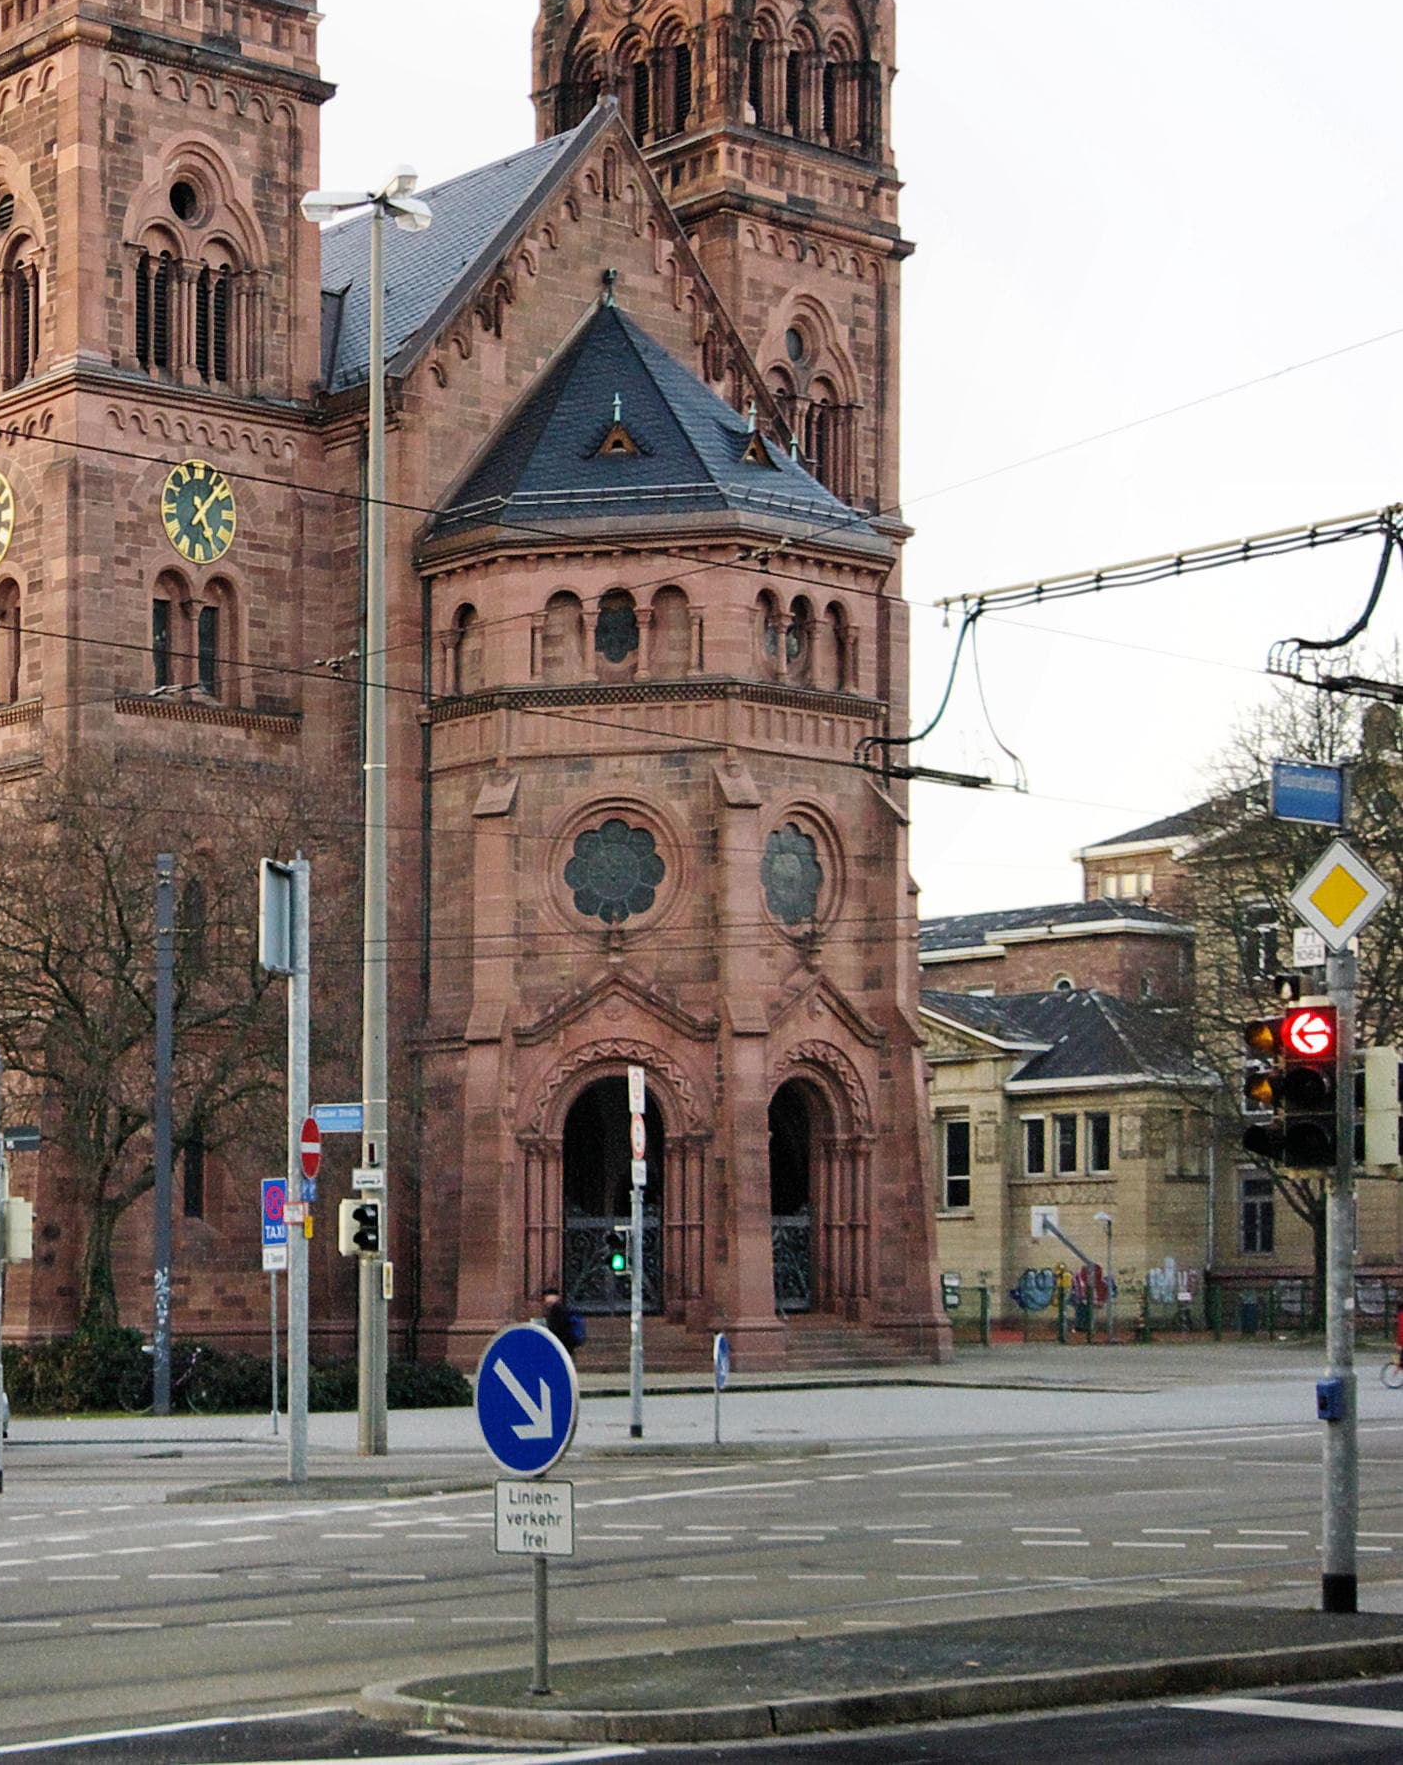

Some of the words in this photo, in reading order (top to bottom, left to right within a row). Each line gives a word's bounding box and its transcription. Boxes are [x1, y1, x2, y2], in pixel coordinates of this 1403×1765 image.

[265, 1224, 285, 1239] TAXI
[508, 1488, 559, 1505] Linien-
[506, 1510, 563, 1527] verkehr
[523, 1530, 548, 1547] frei
